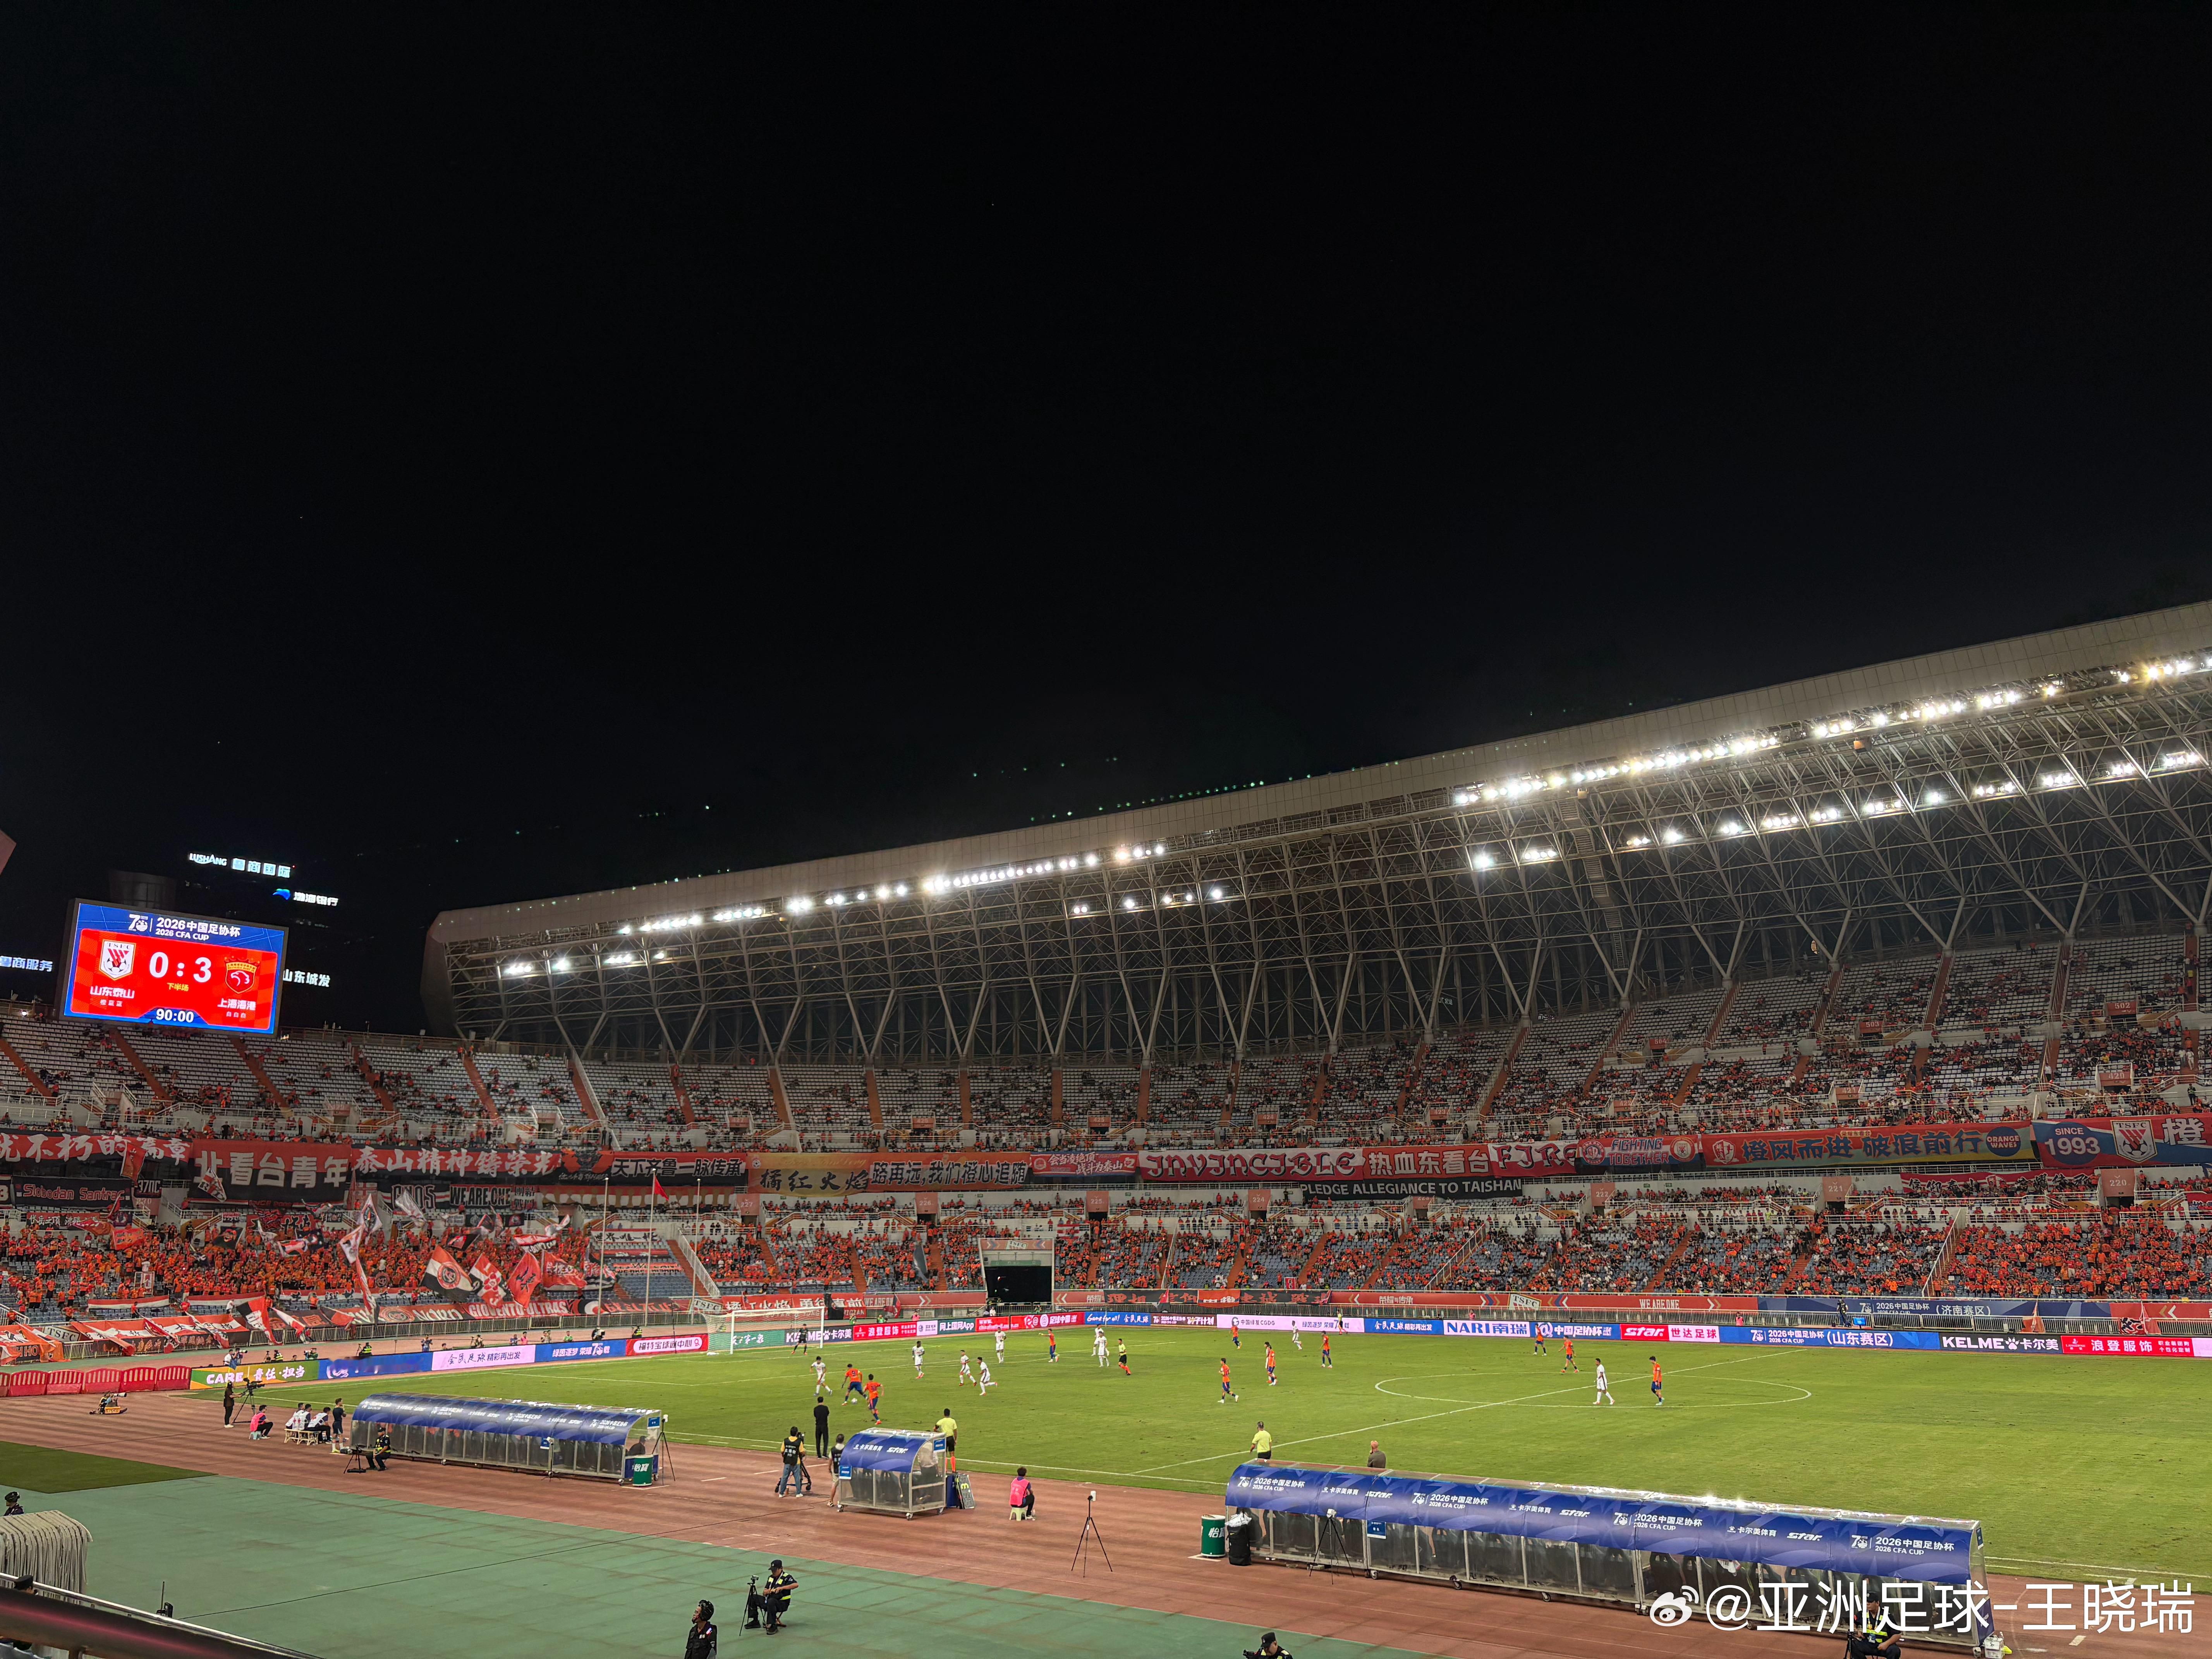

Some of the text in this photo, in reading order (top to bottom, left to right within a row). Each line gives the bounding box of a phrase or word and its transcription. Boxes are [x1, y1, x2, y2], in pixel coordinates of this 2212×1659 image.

[189, 853, 227, 866] LUSHANG
[293, 891, 338, 906] 渤海银行
[155, 928, 173, 937] 2026
[175, 931, 191, 939] CFA
[156, 917, 240, 937] 2026中国足协杯
[283, 969, 330, 988] 山东城发
[90, 986, 135, 999] 山东泰山
[217, 998, 256, 1011] 上海海港
[156, 1009, 194, 1023] 90:00
[1611, 1138, 1664, 1151] FIGHTING
[1862, 1130, 1984, 1157] 破浪前行
[2044, 1137, 2100, 1155] 1993
[1368, 1149, 1490, 1176] 热血东看台
[1607, 1152, 1669, 1165] TOGETHER
[194, 1150, 349, 1188] 北看台青年
[612, 1158, 743, 1177] 天下齐鲁一脉传承
[760, 1169, 869, 1191] 橘红火焰
[23, 1184, 125, 1200] Slobodan Santrac
[1301, 1179, 1522, 1195] PLEDGE ALLEGIANCE TO TAISHAN
[451, 1186, 466, 1205] WE
[467, 1187, 489, 1206] ARE
[491, 1188, 511, 1206] ONE
[1513, 1295, 1537, 1308] TSFC
[1639, 1299, 1680, 1309] WE ARE ONE
[1876, 1302, 1930, 1310] 2026中国足协杯
[46, 1328, 76, 1341] TSFC
[1447, 1322, 1527, 1335] NARI 南瑞
[1554, 1326, 1602, 1337] 中国足协杯
[1671, 1328, 1717, 1339] 世达足球
[1768, 1329, 1824, 1340] 2026中国足协杯
[786, 1329, 852, 1343] KEME 卡尔美
[1942, 1336, 2004, 1350] KELME
[2020, 1338, 2059, 1351] 卡尔美
[2091, 1340, 2153, 1352] 浪登服饰
[448, 1351, 521, 1364] 全民足球精彩再出发
[206, 1371, 244, 1384] CARE
[1253, 1477, 1305, 1488] 2026中国足协杯
[1329, 1487, 1359, 1496] 卡尔美体育
[1430, 1494, 1489, 1505] 2026中国足协杯
[1517, 1504, 1590, 1518] 卡尔美体育 star
[1635, 1513, 1703, 1527] 2026中国足协杯
[1737, 1525, 1824, 1542] 卡尔美体育 star
[1874, 1544, 1924, 1556] 2026 CFA CUP
[1875, 1536, 1955, 1552] 2026中国足协杯
